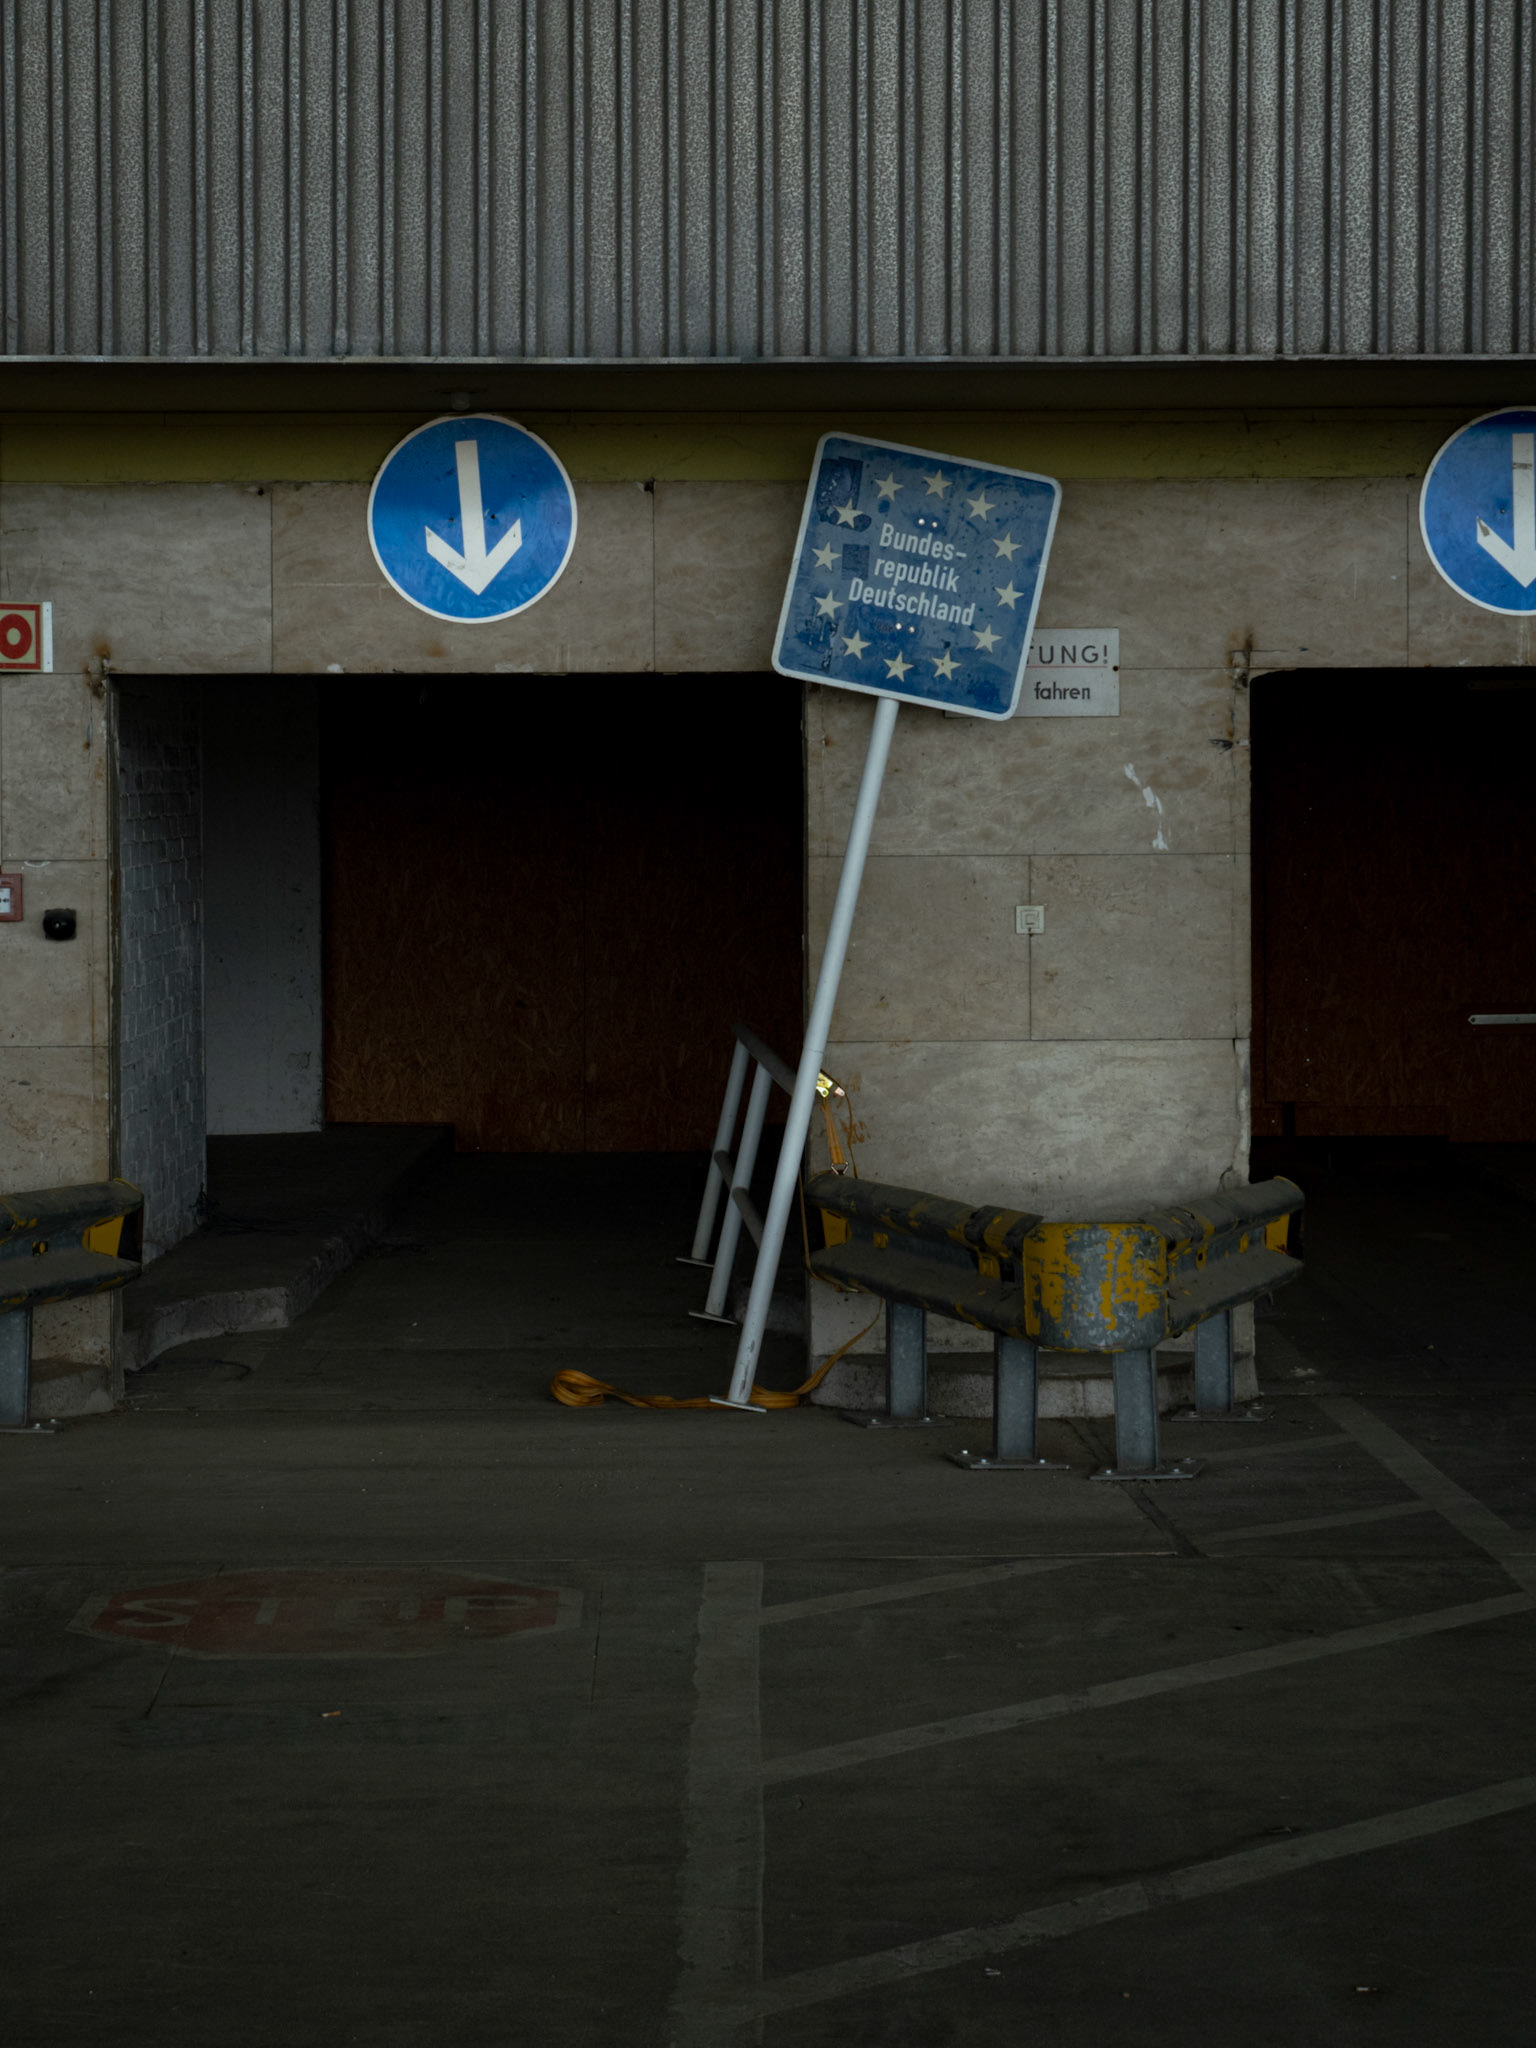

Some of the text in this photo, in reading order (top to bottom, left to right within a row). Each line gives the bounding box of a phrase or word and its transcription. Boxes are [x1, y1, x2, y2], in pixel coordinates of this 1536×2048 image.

[880, 523, 967, 560] Bundes-
[874, 558, 960, 593] republik
[848, 577, 976, 626] Deutschland
[1034, 681, 1091, 700] fahren
[115, 1595, 536, 1627] STOP
